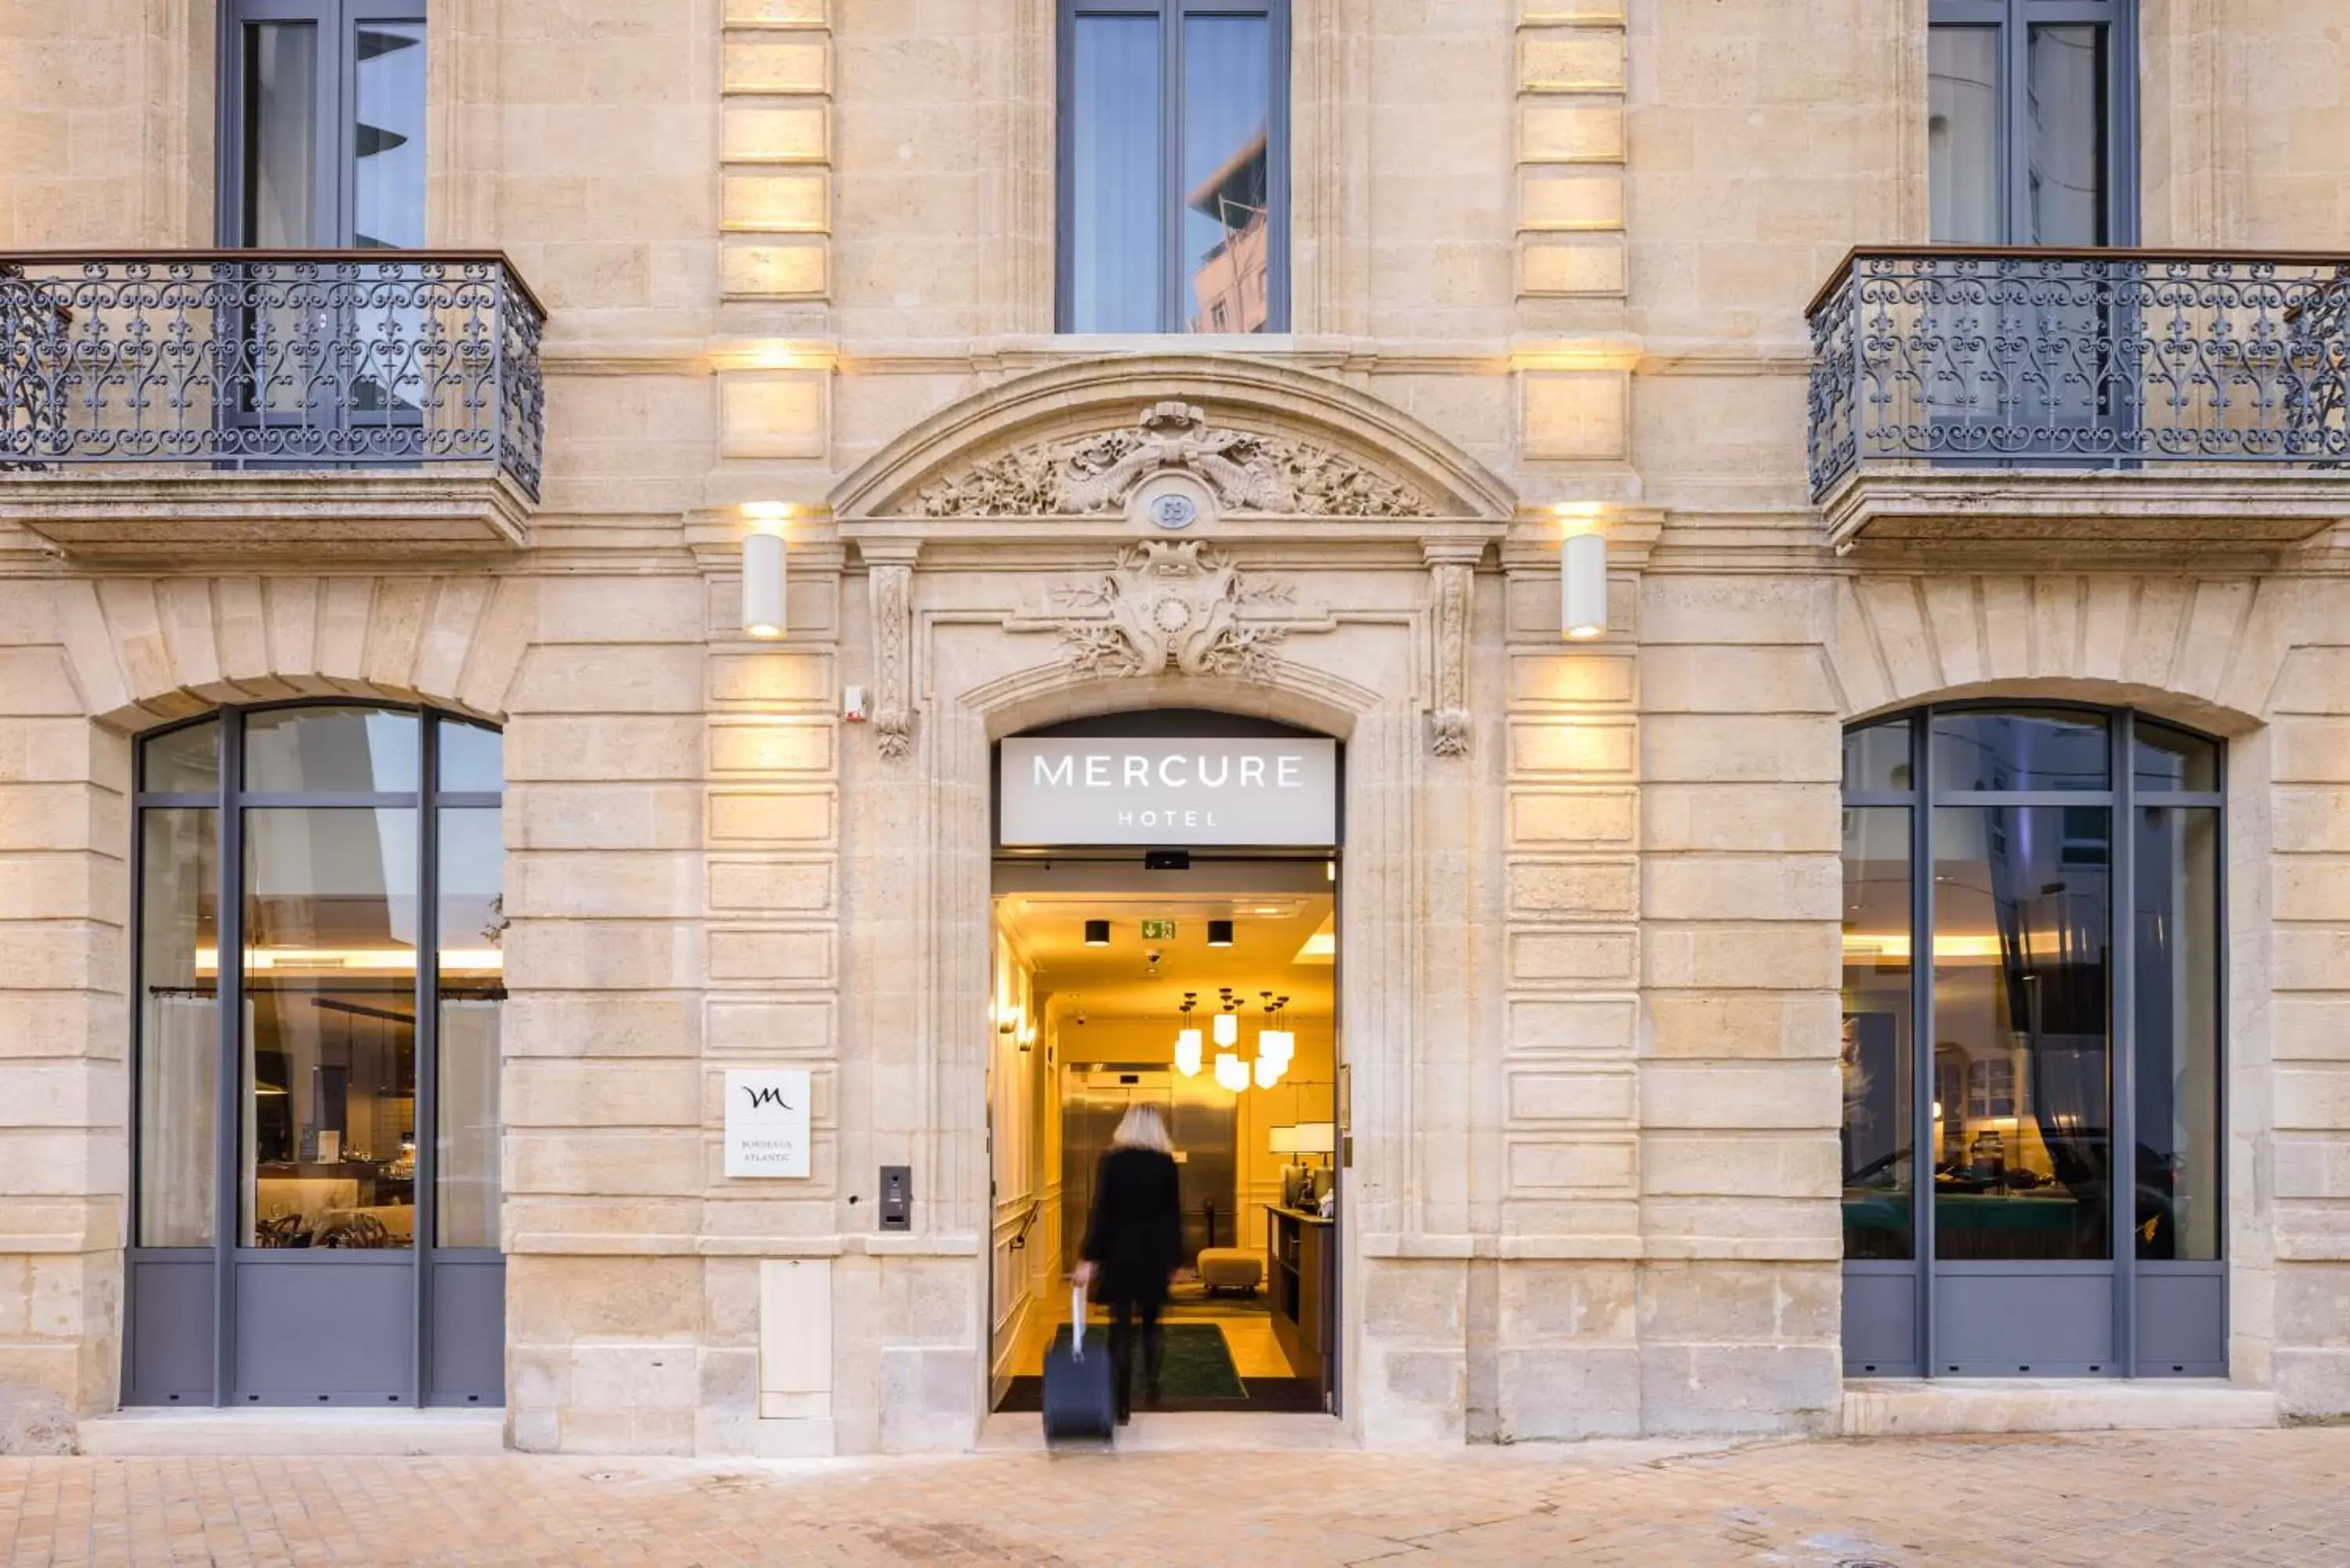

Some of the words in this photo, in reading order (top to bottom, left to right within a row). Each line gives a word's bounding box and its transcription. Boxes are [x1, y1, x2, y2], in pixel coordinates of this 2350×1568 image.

[1032, 754, 1304, 788] MERCURE
[1117, 811, 1217, 827] HOTEL
[741, 1140, 793, 1148] BORDEAUX
[743, 1153, 790, 1162] ATLANTIC
